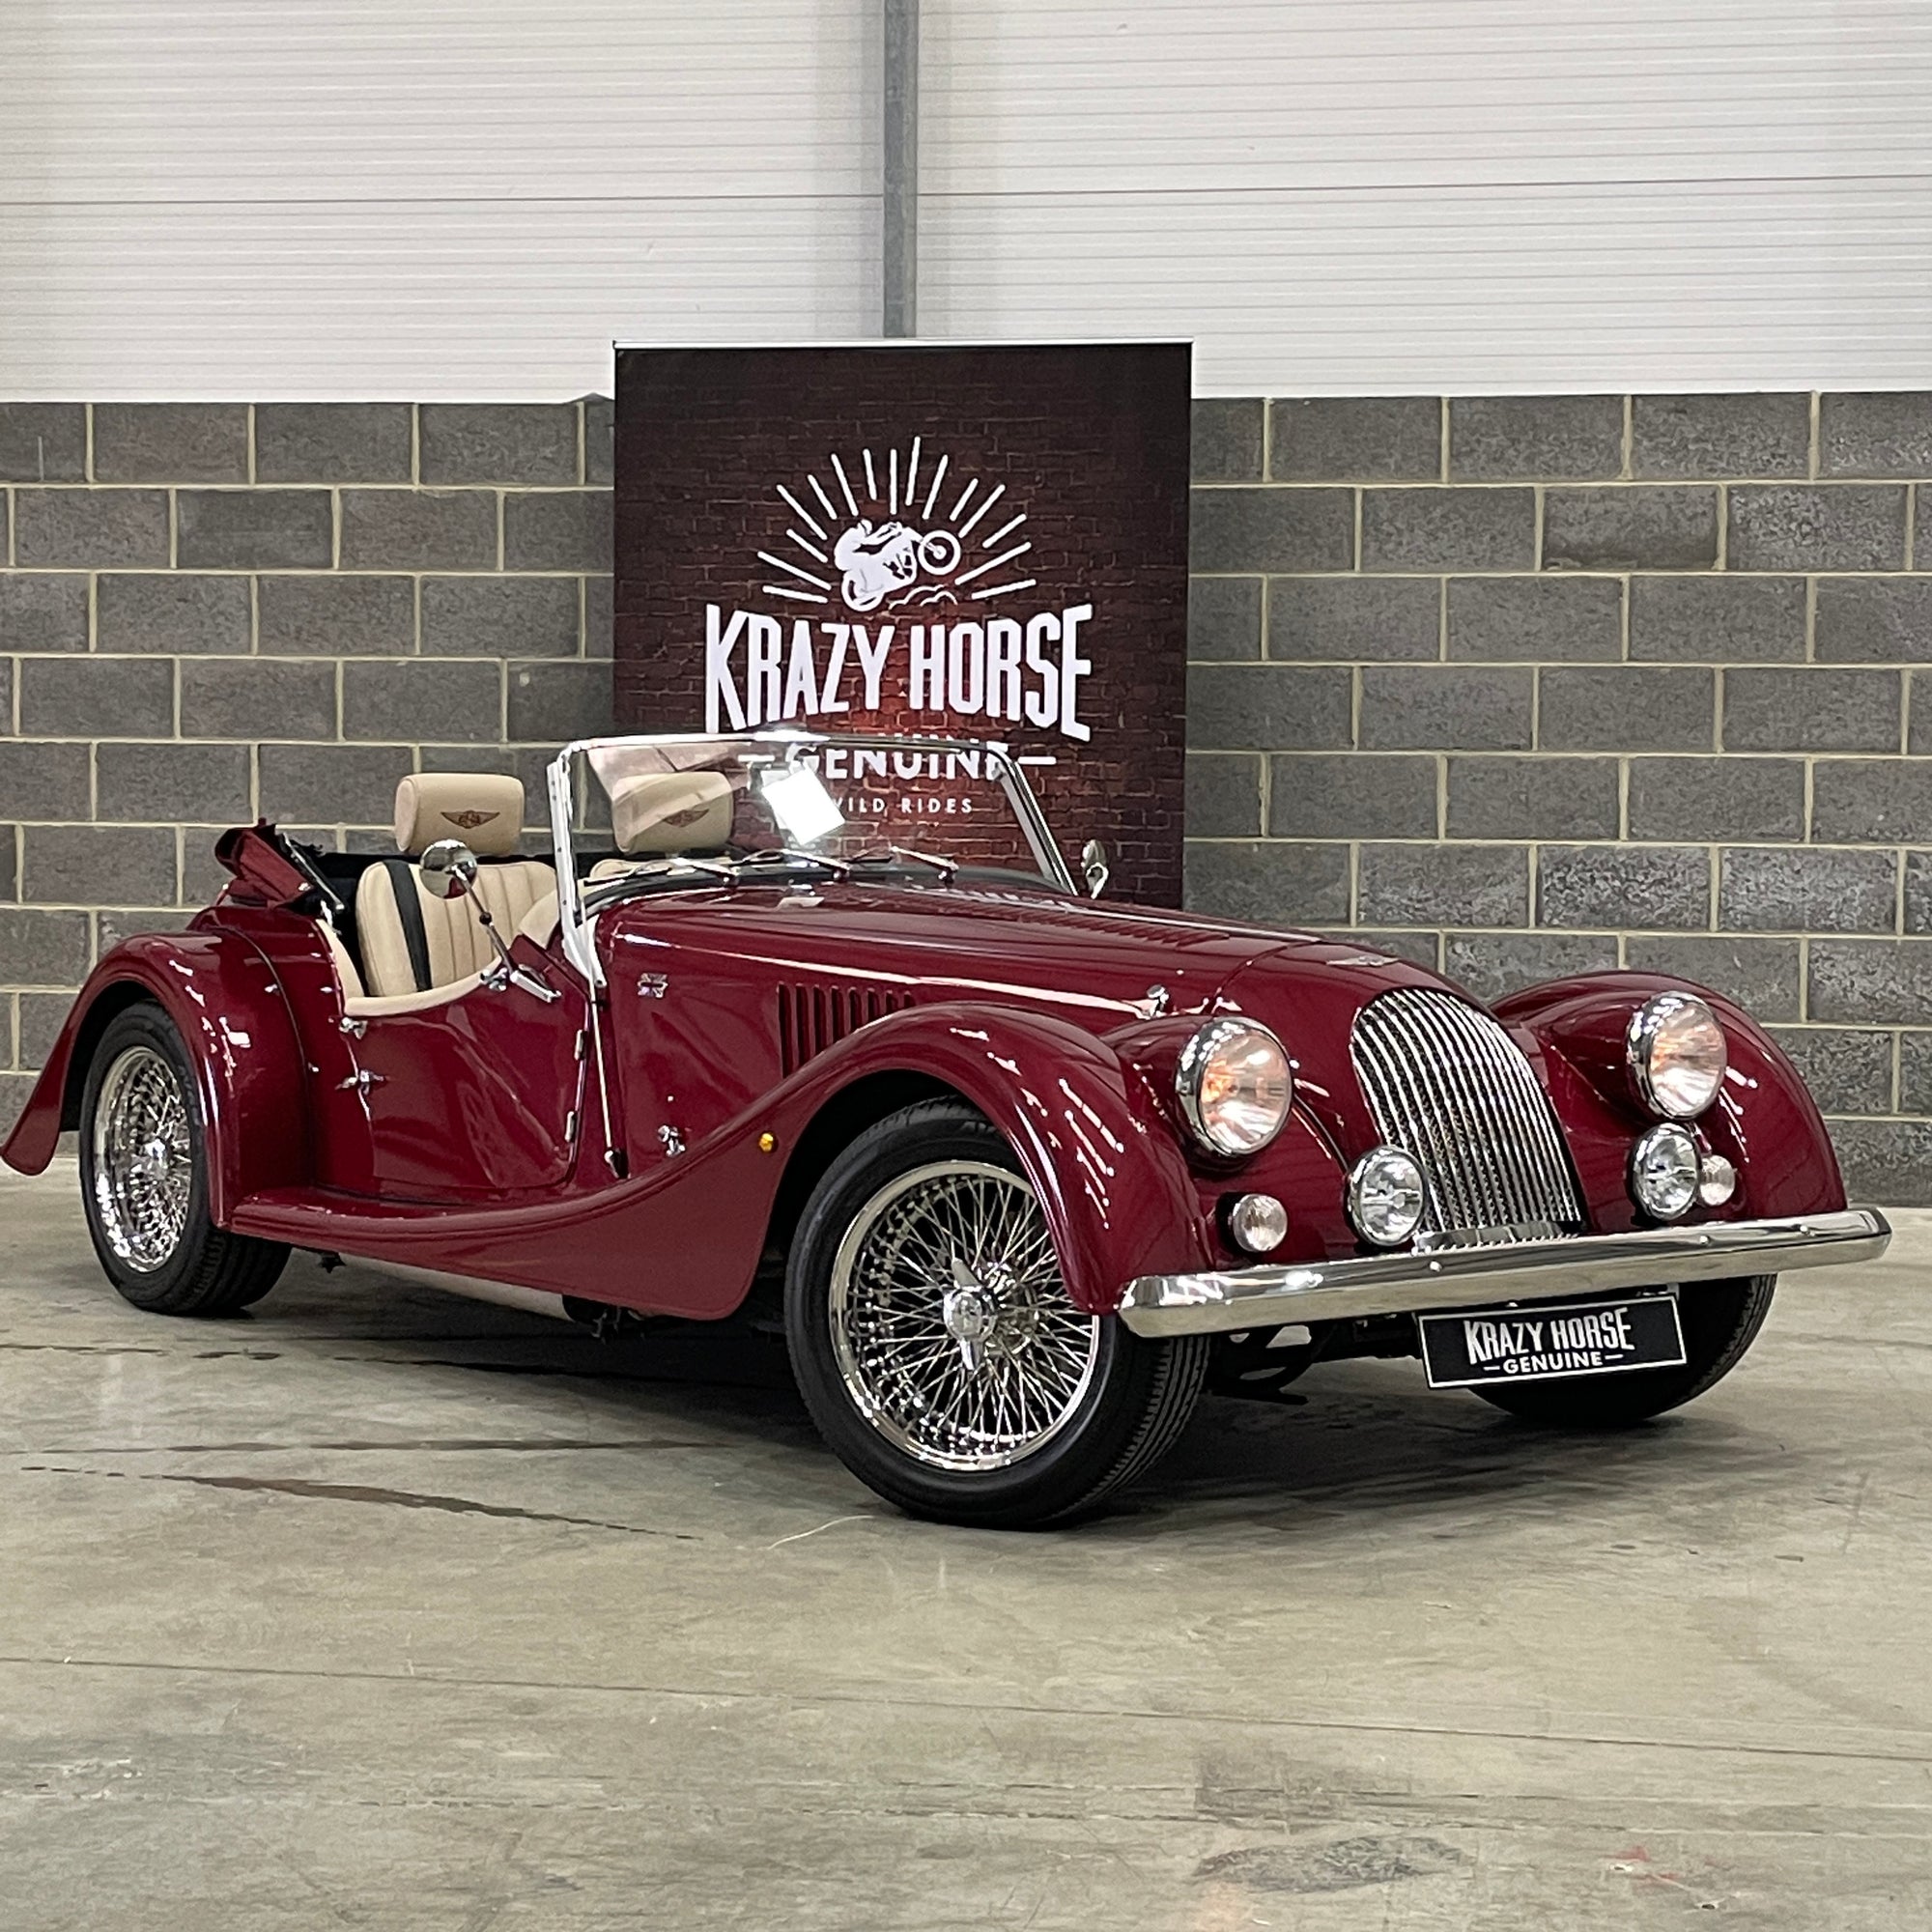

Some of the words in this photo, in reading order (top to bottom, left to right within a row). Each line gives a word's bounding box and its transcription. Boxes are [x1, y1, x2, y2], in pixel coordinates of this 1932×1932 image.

[706, 604, 895, 734] KRAZY
[909, 604, 1093, 742] HORSE
[901, 798, 972, 813] RIDES
[1463, 1320, 1543, 1365] KRAZY
[1551, 1307, 1634, 1350] HORSE
[1503, 1351, 1603, 1374] GENUINE
